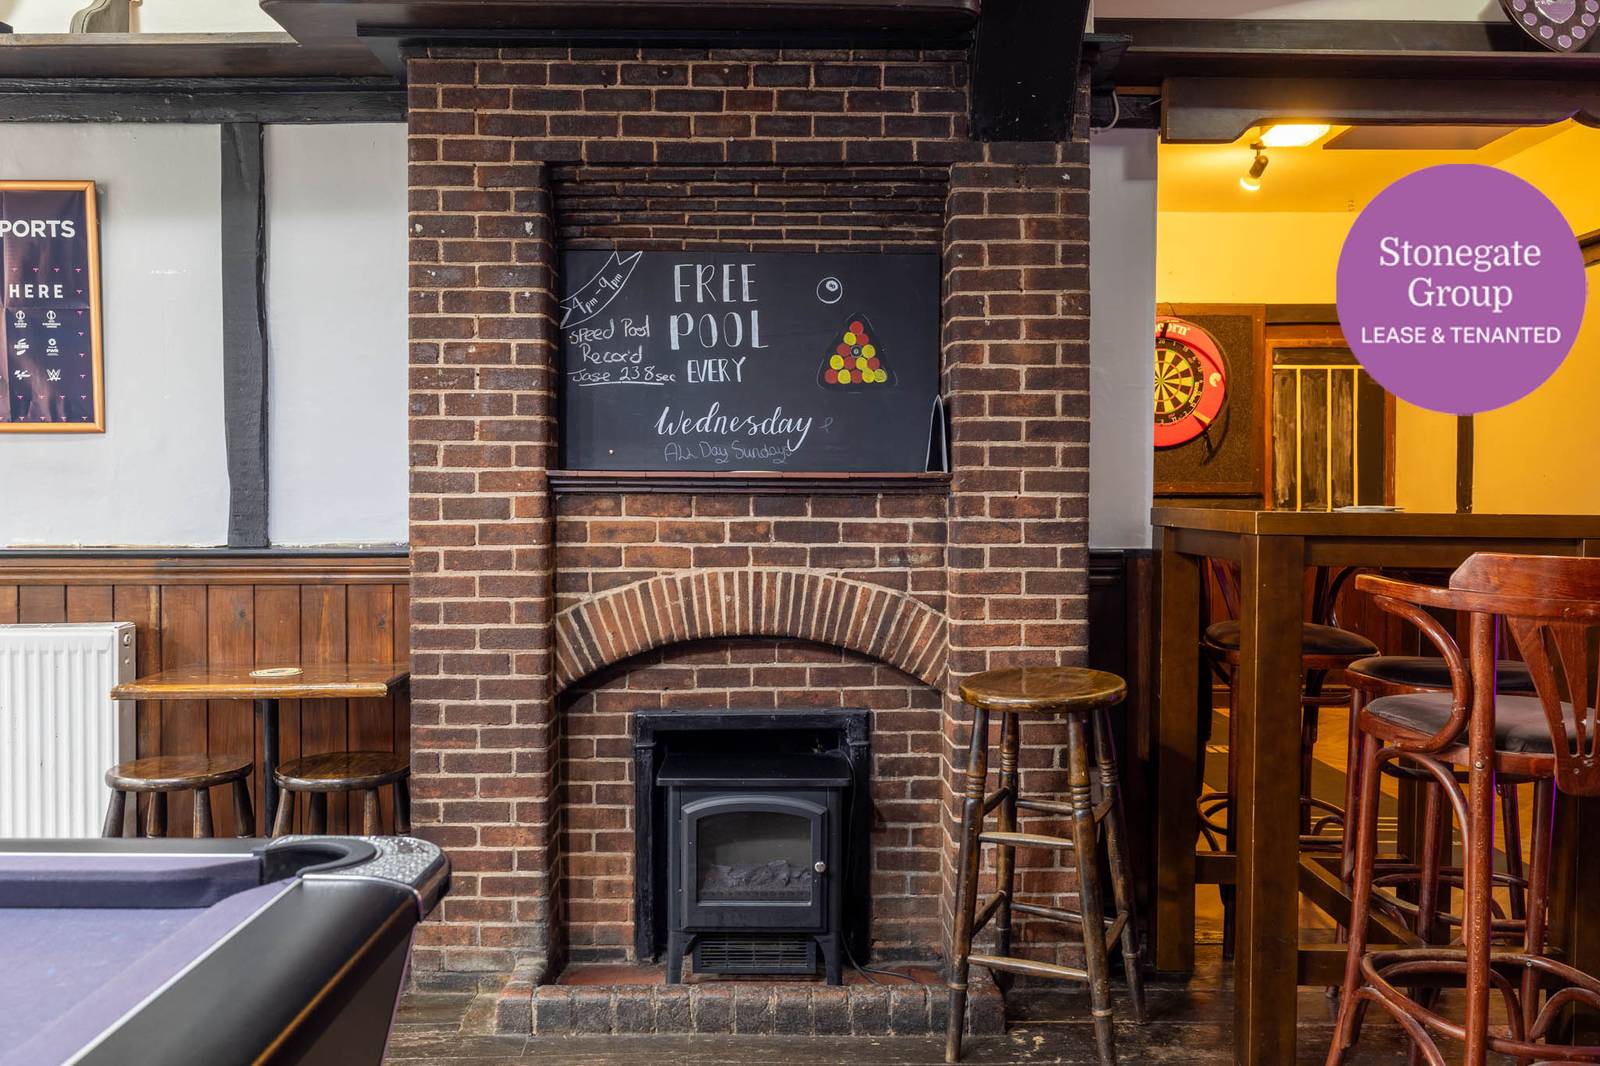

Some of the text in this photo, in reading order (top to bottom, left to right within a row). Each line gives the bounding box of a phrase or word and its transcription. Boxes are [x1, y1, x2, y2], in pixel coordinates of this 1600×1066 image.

[9, 284, 64, 298] HERE
[674, 263, 758, 303] FREE
[669, 310, 769, 350] POOL
[579, 342, 643, 364] Record
[687, 356, 746, 383] EVERY
[655, 401, 813, 452] Wednesday
[699, 440, 729, 464] Day
